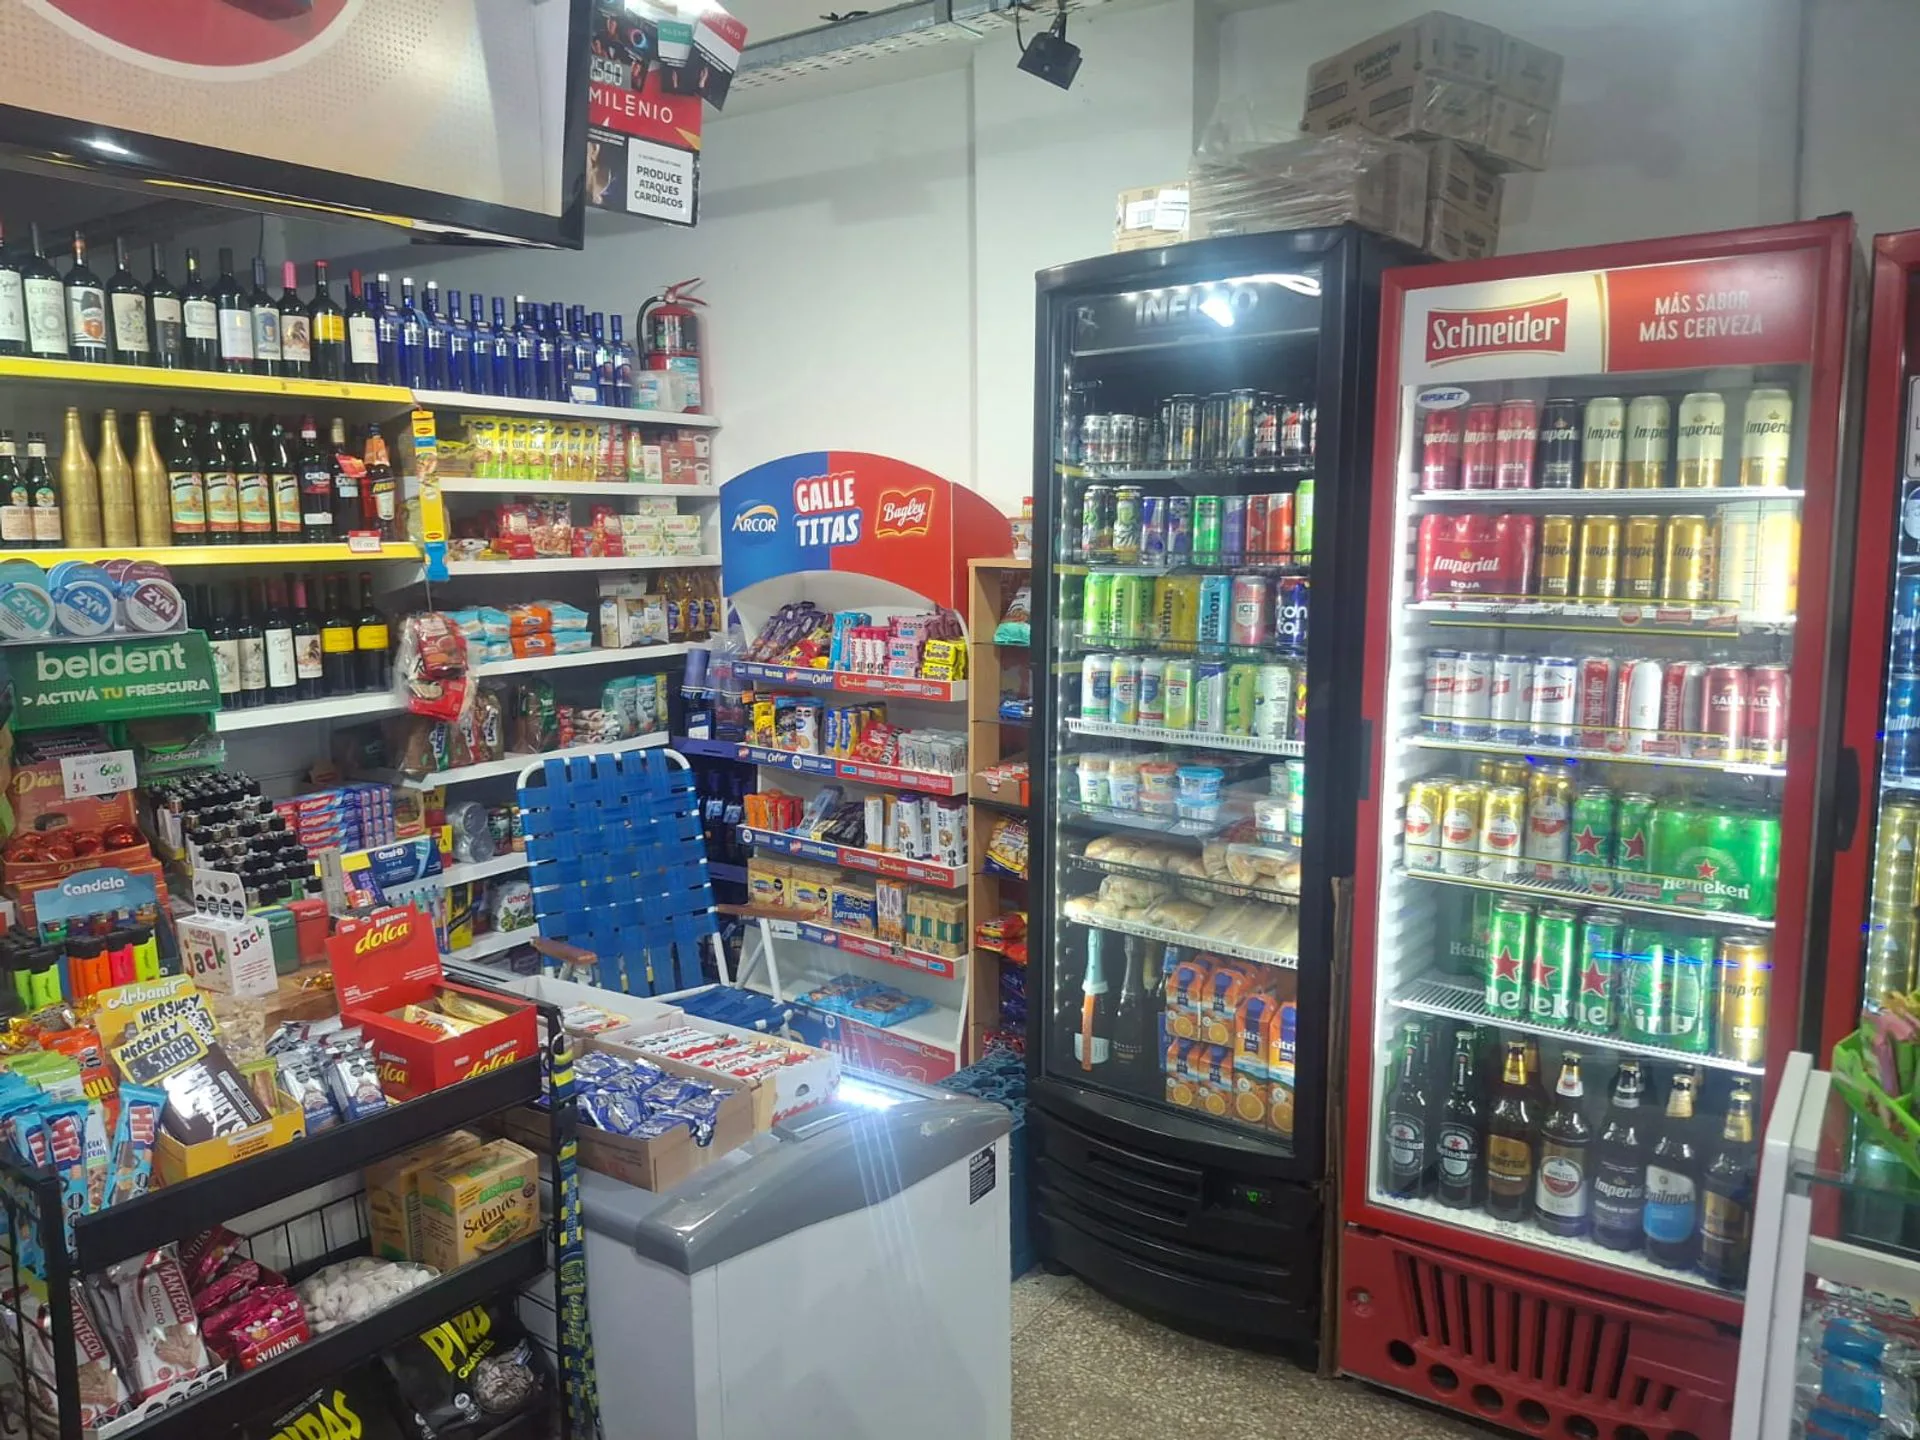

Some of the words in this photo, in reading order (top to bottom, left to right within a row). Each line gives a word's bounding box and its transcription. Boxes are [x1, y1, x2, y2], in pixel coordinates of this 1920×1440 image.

[588, 86, 674, 124] MILENIO
[636, 165, 683, 185] PRODUCE
[639, 179, 680, 196] ATAQUES
[634, 189, 684, 209] CARDÍACOS
[1655, 292, 1691, 316] MÁS
[1695, 290, 1750, 313] SABOR
[1431, 310, 1561, 351] Schneider
[1639, 317, 1678, 343] MÁS
[1683, 311, 1763, 340] CERVEZA
[796, 477, 856, 513] GALLE
[731, 514, 778, 534] ARCOR
[882, 497, 928, 527] Bagley
[796, 513, 860, 546] TITAS
[1432, 555, 1501, 574] Imperial
[72, 590, 107, 616] ZYN
[142, 588, 175, 615] ZYN
[36, 641, 187, 683] beldent
[36, 690, 99, 707] ACTIVÁ
[101, 687, 124, 702] TU
[125, 679, 210, 698] FRESCURA
[301, 796, 334, 810] Colgate
[302, 827, 335, 841] Colgate
[62, 875, 126, 897] Candela
[232, 925, 266, 956] jack
[355, 922, 409, 954] dolca
[183, 935, 227, 978] jack
[119, 1019, 181, 1061] HERSHEY
[463, 1194, 517, 1238] Salmas
[156, 1259, 195, 1325] MANTECOL
